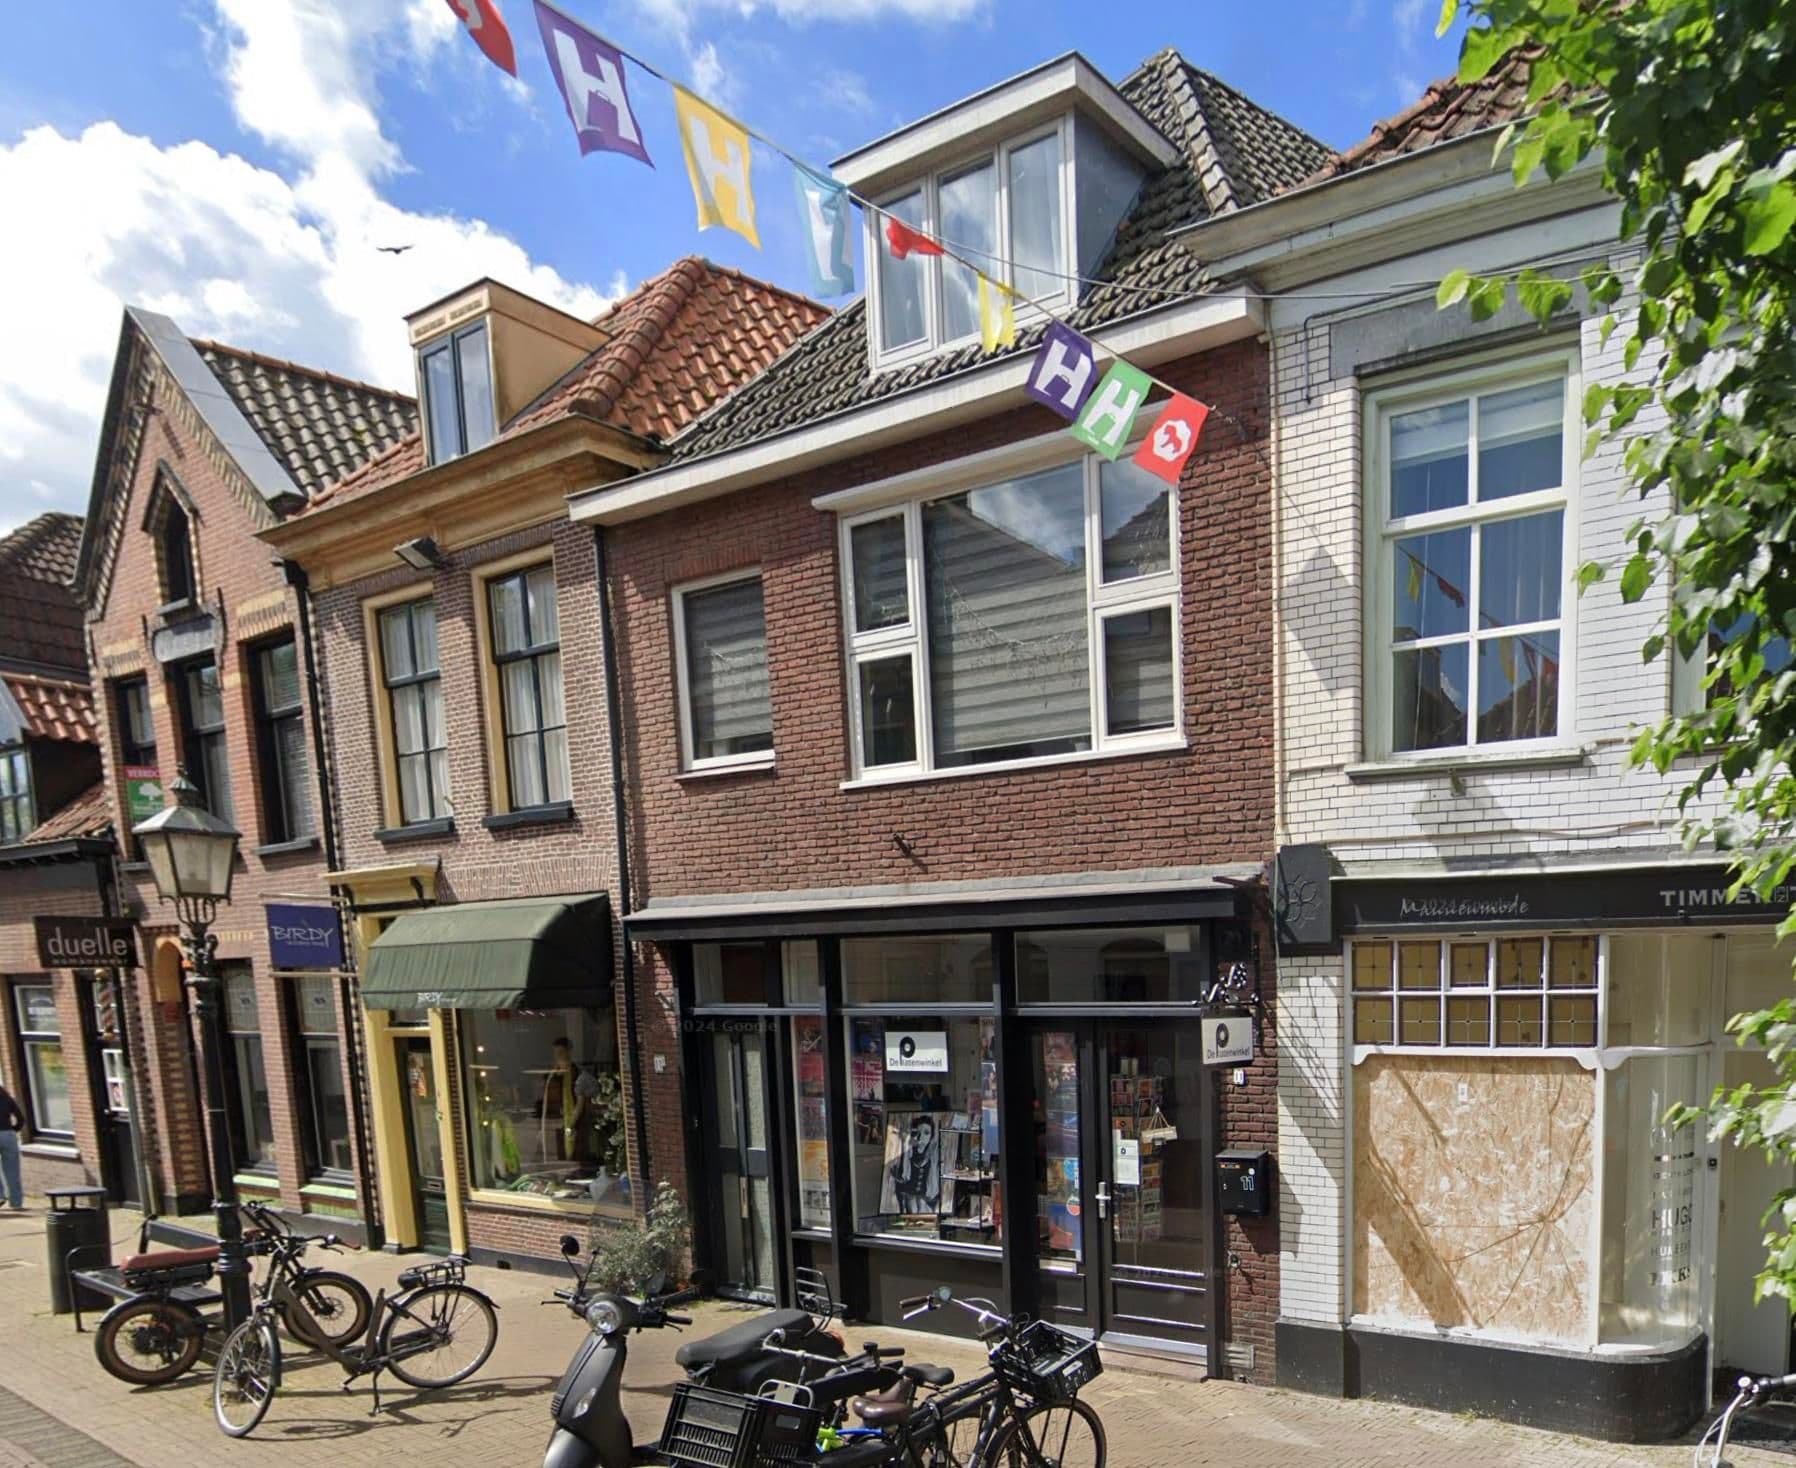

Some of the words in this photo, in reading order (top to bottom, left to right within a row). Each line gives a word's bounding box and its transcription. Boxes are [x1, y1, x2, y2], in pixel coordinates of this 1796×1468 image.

[48, 926, 128, 956] duelle
[271, 925, 335, 949] BIRDY
[1239, 1175, 1255, 1191] 11
